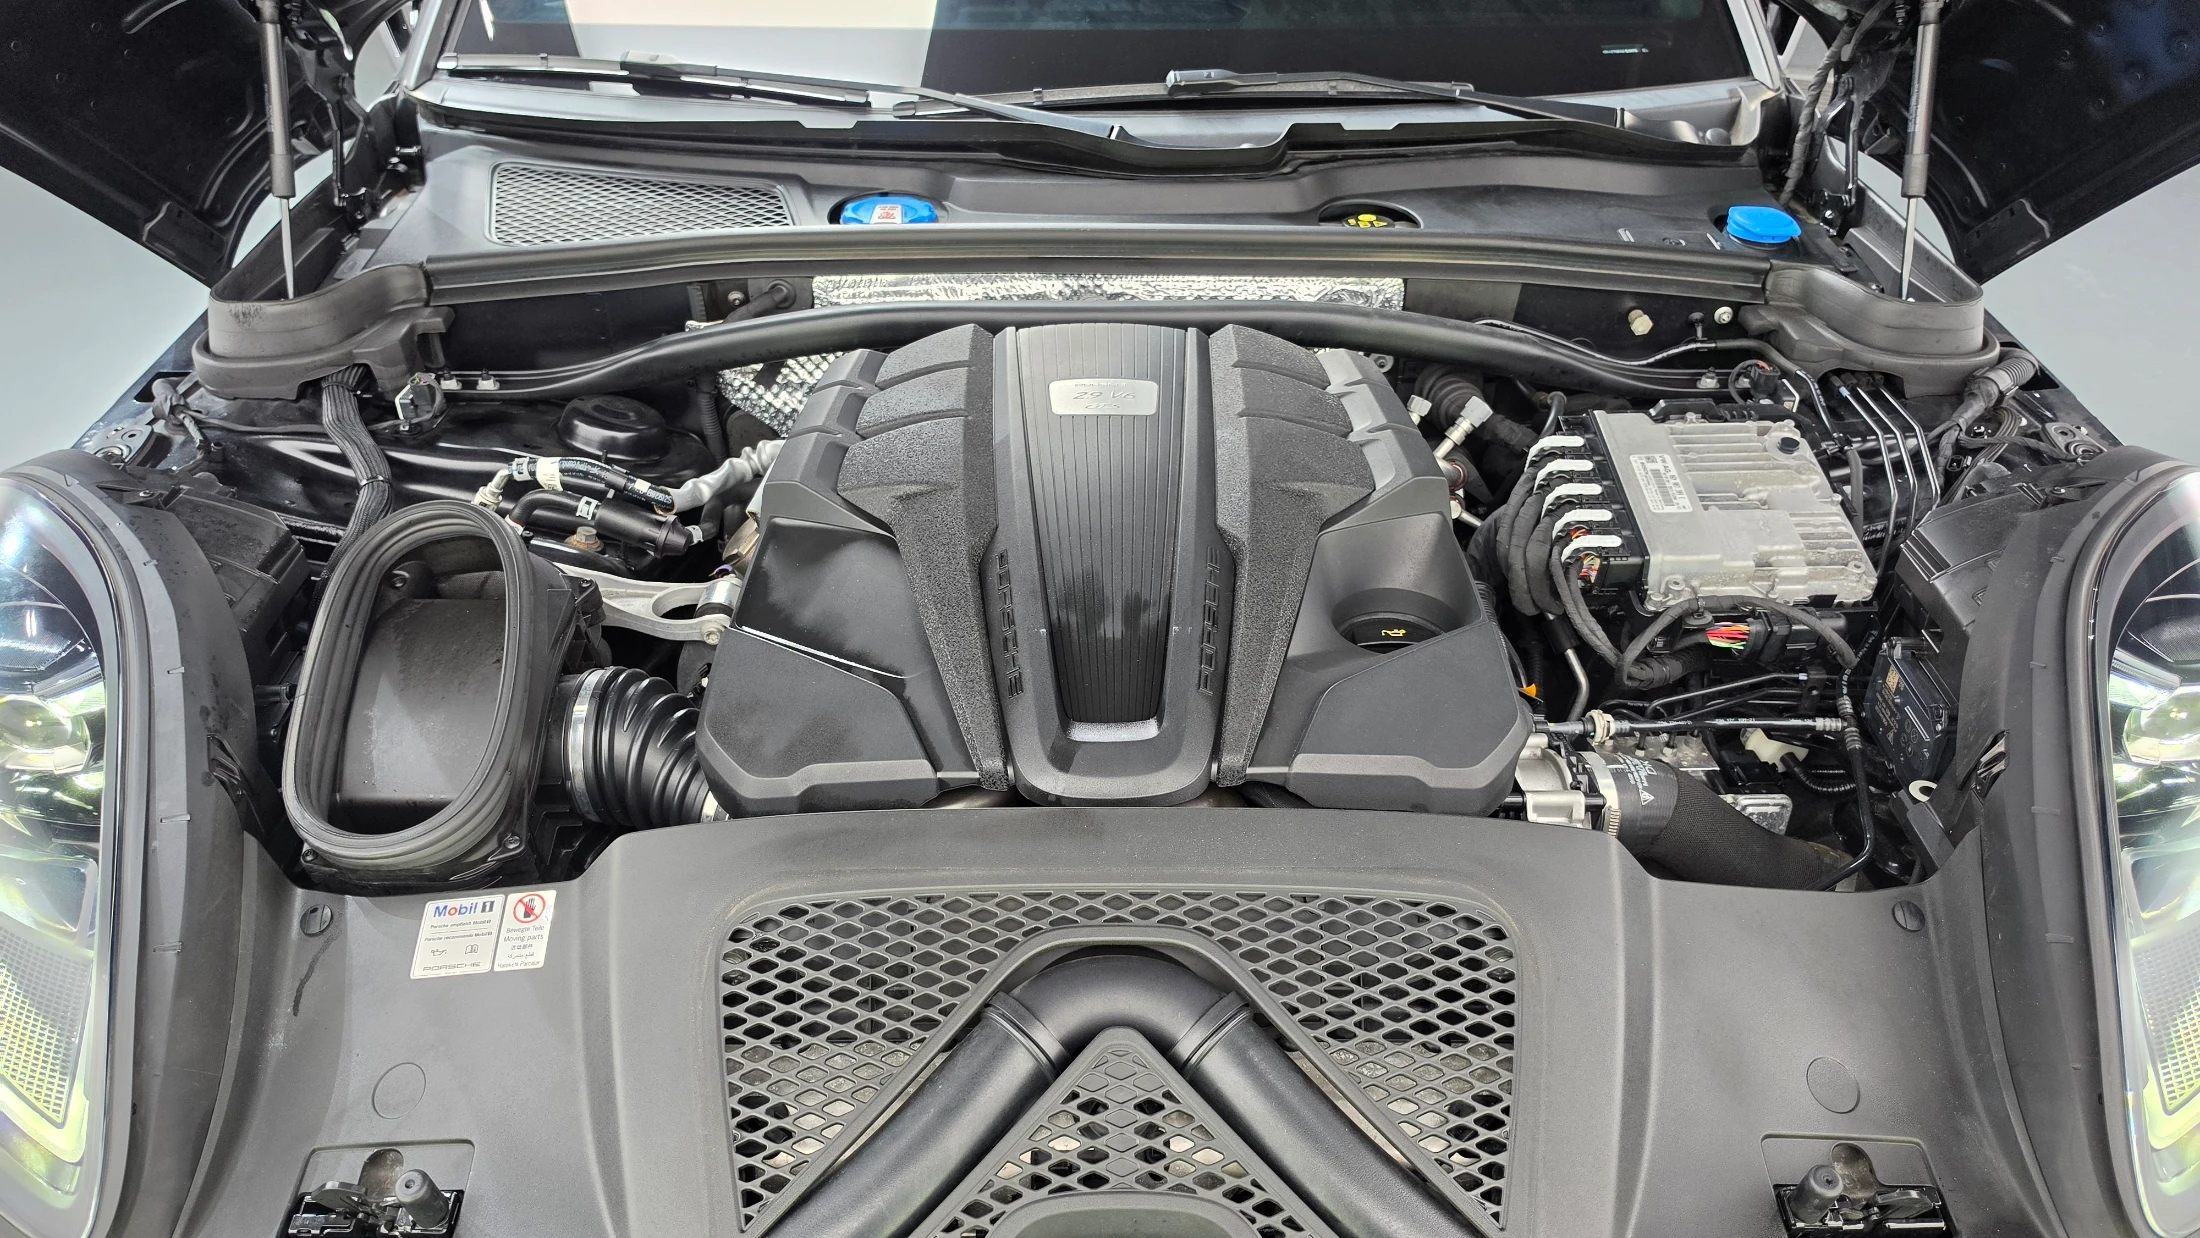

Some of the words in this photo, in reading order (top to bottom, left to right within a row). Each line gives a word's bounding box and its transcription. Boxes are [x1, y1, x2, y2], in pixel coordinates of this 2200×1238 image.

[1072, 391, 1103, 400] 2.9
[1110, 390, 1136, 400] V6
[995, 548, 1024, 699] PORSCHE
[1198, 546, 1220, 697] PORSCHE
[433, 902, 479, 918] Mobil
[481, 900, 496, 913] 1
[527, 934, 544, 942] parts
[422, 962, 482, 972] PORSCHE
